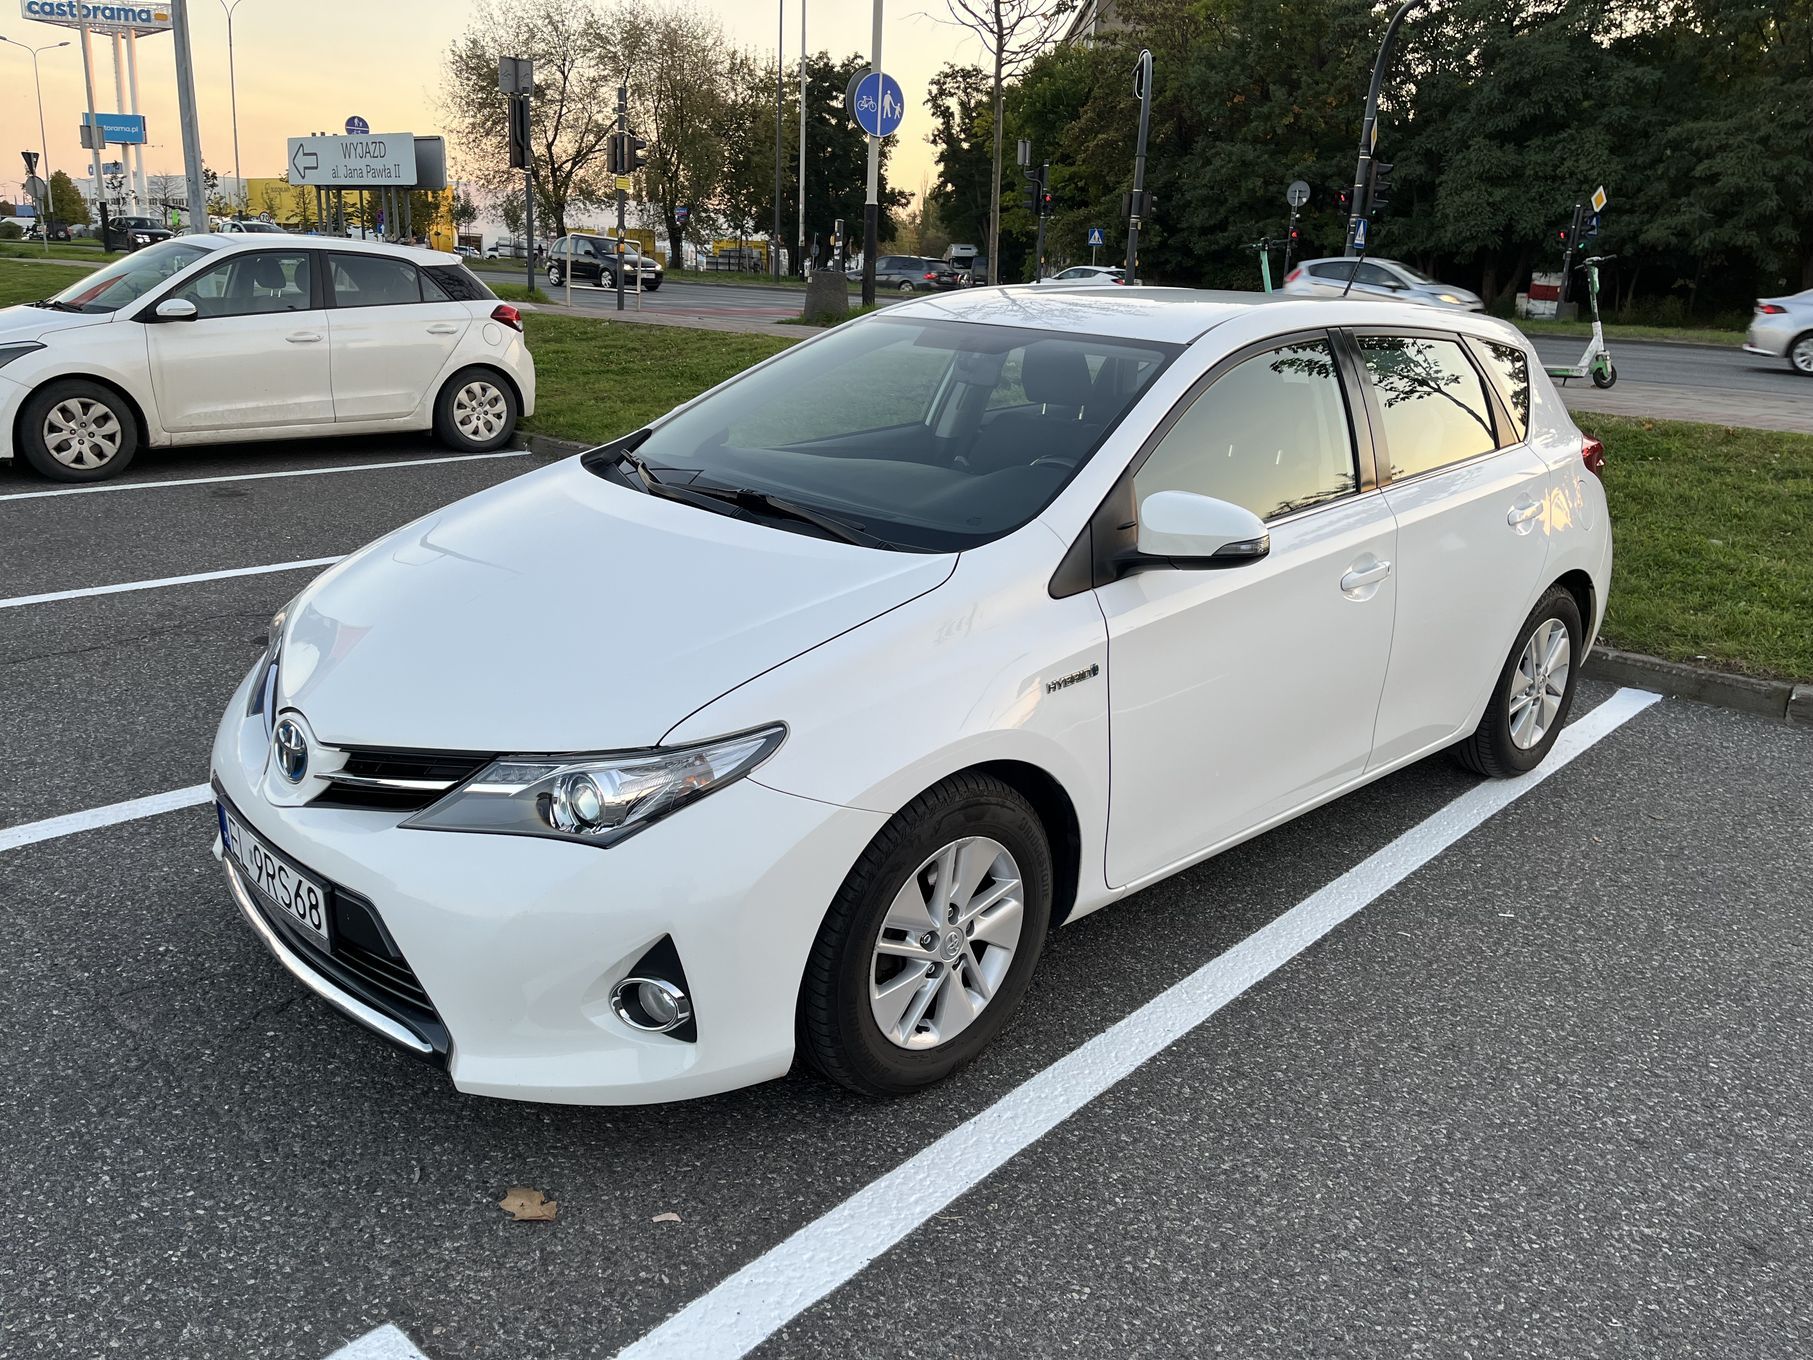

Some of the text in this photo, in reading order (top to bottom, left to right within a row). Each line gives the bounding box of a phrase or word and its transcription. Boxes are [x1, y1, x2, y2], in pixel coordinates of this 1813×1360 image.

[27, 0, 152, 22] castorama
[103, 125, 138, 134] torama.pl
[341, 141, 387, 159] WYJAZD
[331, 163, 401, 179] al. Jana Pawła II
[1045, 667, 1092, 694] HYBRID
[228, 816, 322, 931] EL 9RS68
